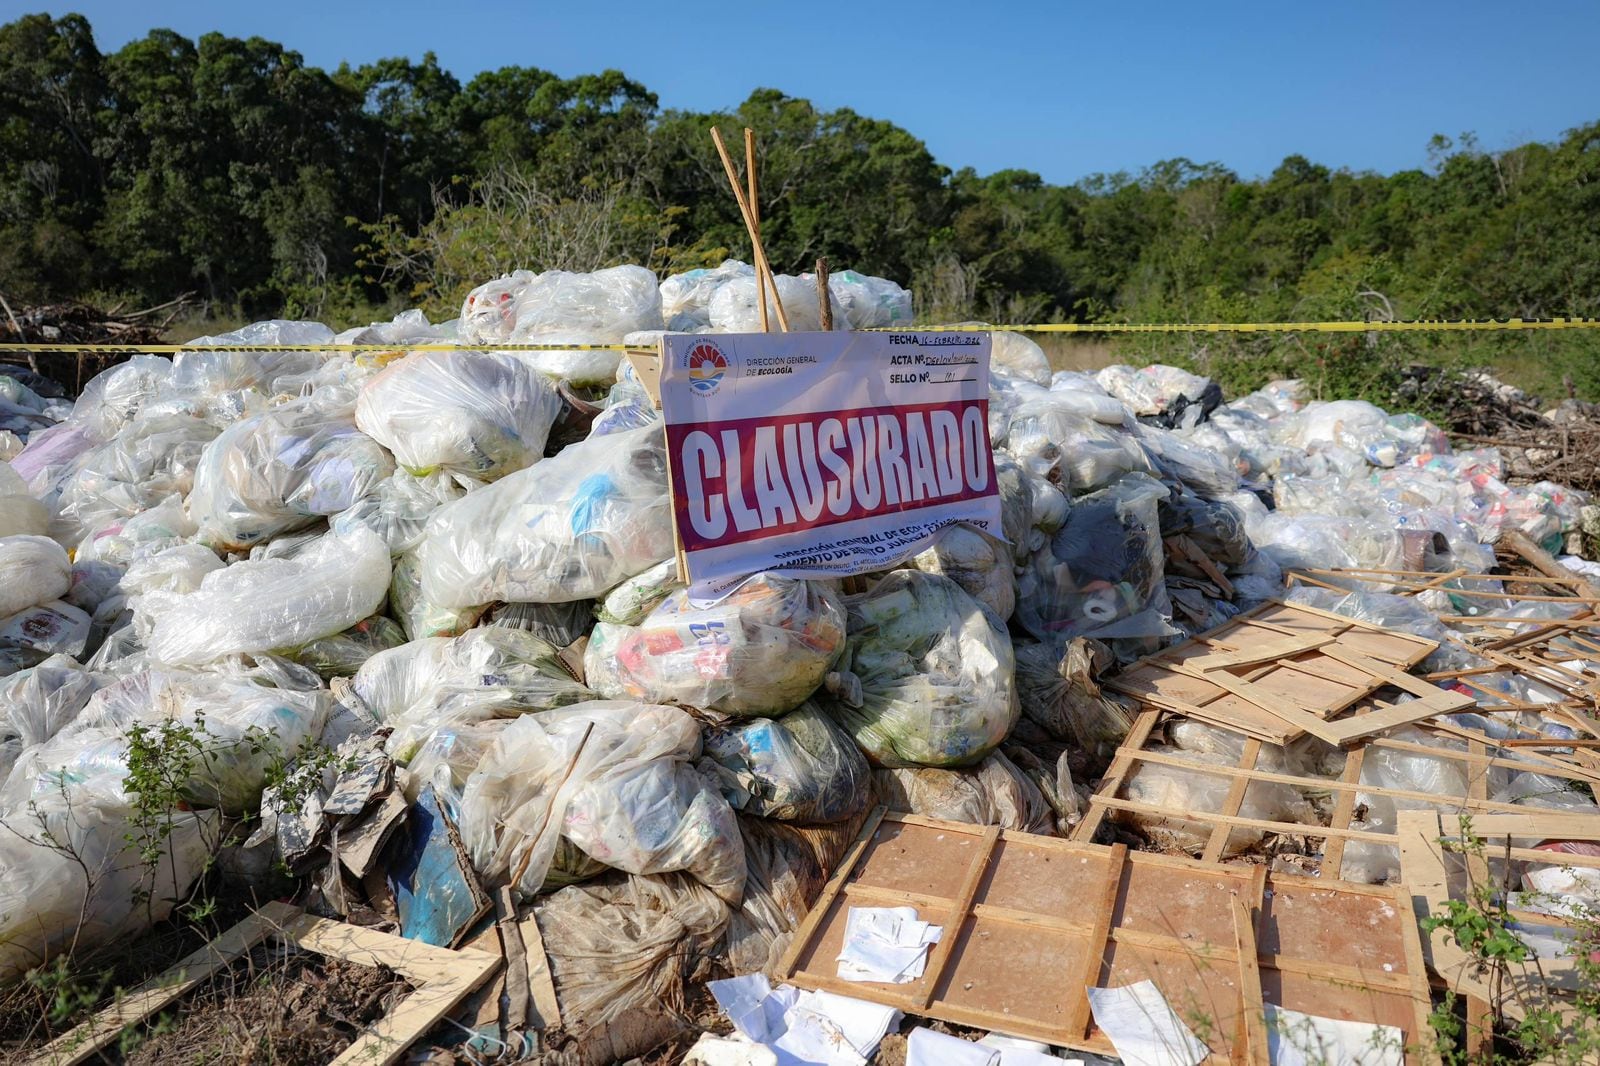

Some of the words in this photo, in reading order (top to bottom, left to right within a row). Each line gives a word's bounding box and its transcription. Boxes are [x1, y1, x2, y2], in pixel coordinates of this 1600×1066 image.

[889, 335, 920, 345] FECHA
[746, 356, 785, 367] DIRECCIÓN
[786, 355, 817, 365] GENERAL
[890, 355, 914, 365] ACTA
[746, 368, 757, 377] DE
[757, 365, 793, 376] ECOLOGÍA
[890, 373, 917, 384] SELLO
[681, 405, 989, 541] CLAUSURADO
[774, 542, 836, 560] DIRECCIÓN
[836, 533, 886, 548] GENERAL
[883, 529, 900, 540] DE
[834, 550, 851, 559] DE
